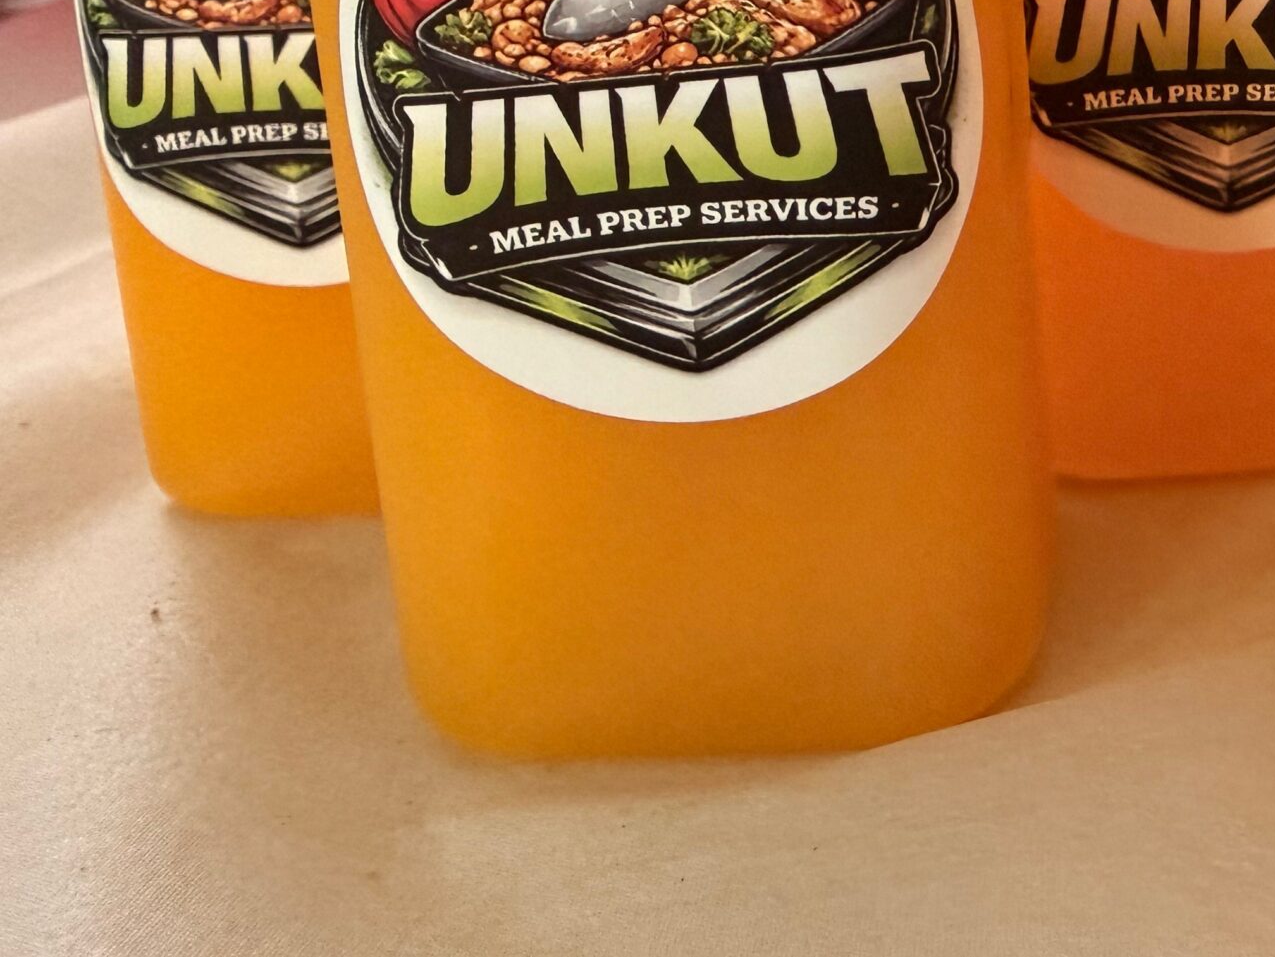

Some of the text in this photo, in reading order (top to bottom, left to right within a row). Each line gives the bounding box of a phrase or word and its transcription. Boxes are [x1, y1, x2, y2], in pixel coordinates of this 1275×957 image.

[102, 32, 325, 129] UNK
[1082, 85, 1162, 111] MEAL
[1167, 84, 1240, 104] PREP
[154, 127, 228, 154] MEAL
[231, 122, 299, 145] PREP
[403, 51, 931, 228] UNKUT
[488, 196, 880, 255] MEAL PREP SERVICES
